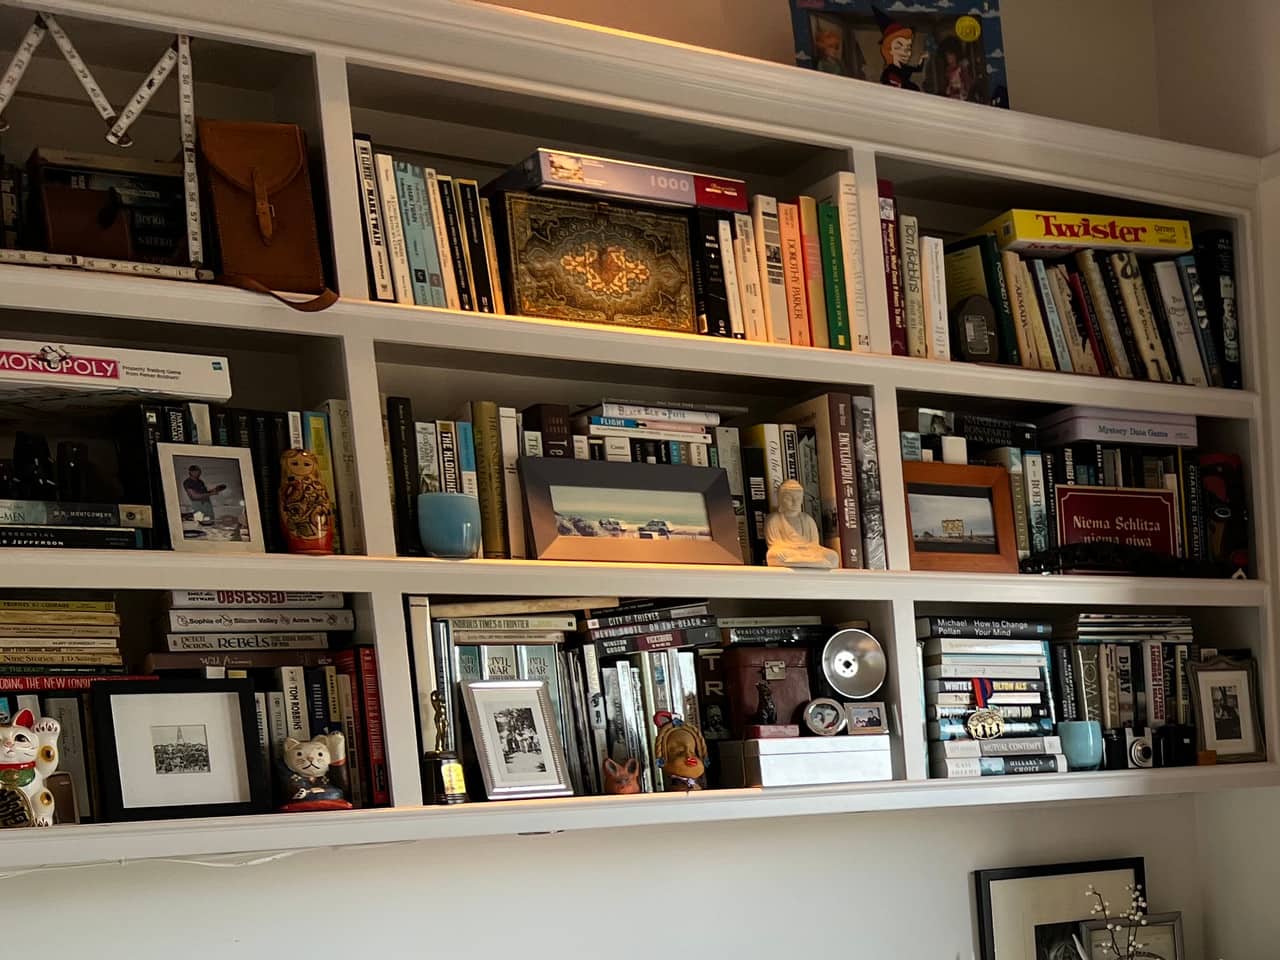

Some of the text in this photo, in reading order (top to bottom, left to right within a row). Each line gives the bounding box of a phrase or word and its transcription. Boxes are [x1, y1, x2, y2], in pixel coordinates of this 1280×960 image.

[650, 175, 689, 192] 1000
[366, 189, 376, 214] MARK
[370, 216, 382, 246] TWAIN
[1036, 214, 1147, 242] Twister
[788, 239, 801, 285] DOROTHY
[905, 221, 919, 293] Tom Robbins
[792, 286, 803, 320] PARKER
[1015, 285, 1029, 328] ARMADA
[600, 418, 625, 426] FLIGHT
[1098, 425, 1168, 438] Mystery Date Game
[441, 432, 452, 449] THE
[838, 432, 853, 484] ENCYCLOPEDIA
[217, 591, 286, 603] OBSESSED
[259, 617, 278, 625] Valley
[609, 616, 622, 626] CITY
[633, 612, 659, 623] THIEVES
[937, 619, 967, 627] Michael
[974, 620, 989, 628] How
[1001, 621, 1028, 630] Change
[938, 627, 961, 635] Pollan
[218, 635, 269, 648] REBELS
[26, 655, 53, 663] Stories
[26, 678, 41, 689] THE
[44, 678, 66, 689] NEW
[944, 681, 968, 691] WHITE
[993, 682, 1028, 690] ILTON ALS
[289, 686, 302, 730] TOM ROBBINS
